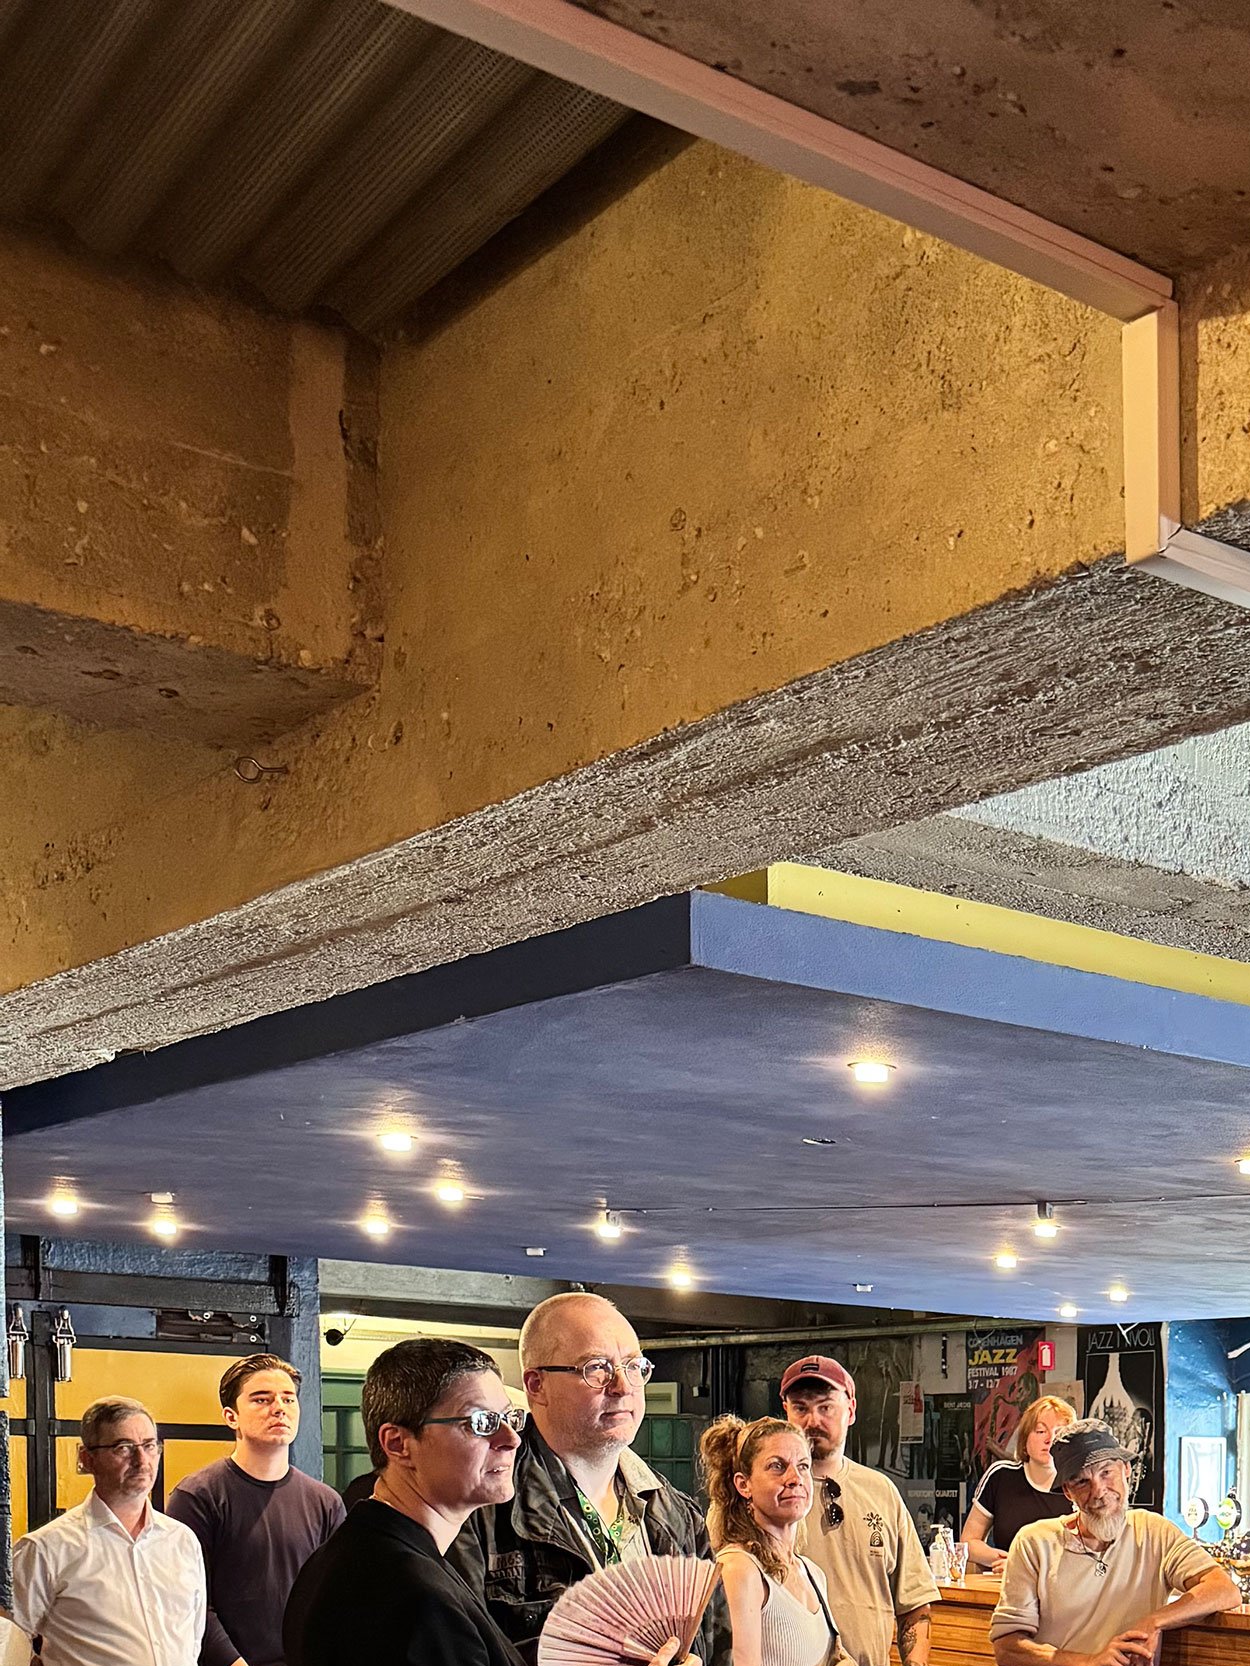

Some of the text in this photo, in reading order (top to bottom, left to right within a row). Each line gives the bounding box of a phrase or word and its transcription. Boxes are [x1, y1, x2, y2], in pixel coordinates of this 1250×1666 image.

[1086, 1331, 1114, 1353] JAZZ
[968, 1348, 1018, 1366] JAZZ
[967, 1367, 999, 1379] FESTIVAL
